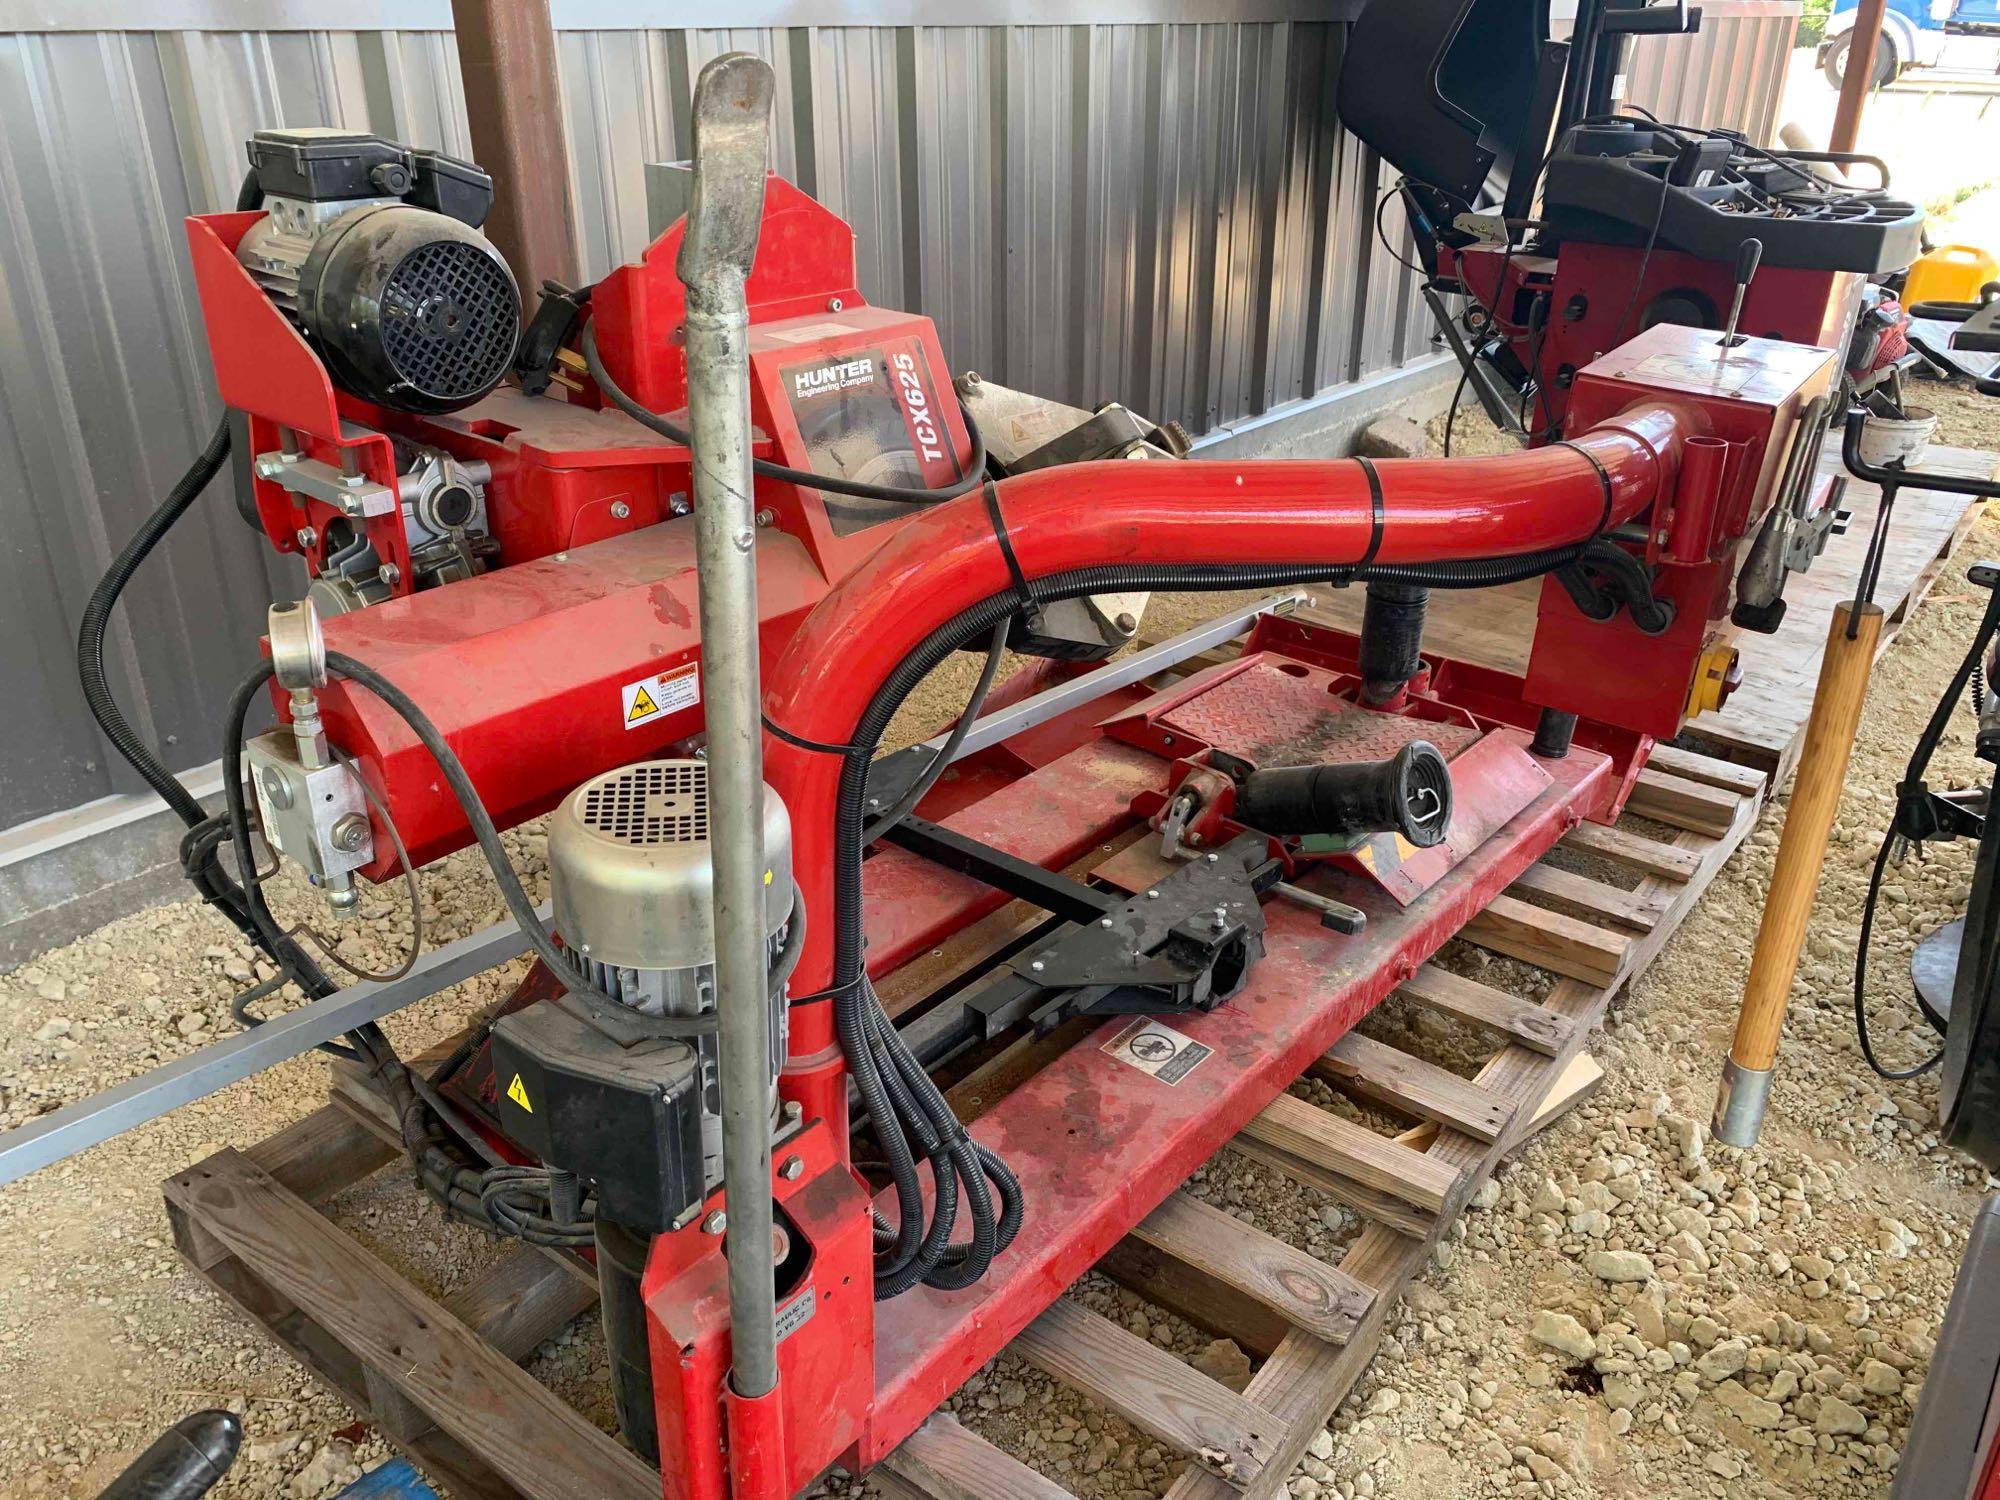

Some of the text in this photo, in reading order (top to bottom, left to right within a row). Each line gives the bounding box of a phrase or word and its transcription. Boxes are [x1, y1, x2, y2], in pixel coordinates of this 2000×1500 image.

[795, 359, 872, 389] HUNTER
[797, 374, 874, 398] Engineering Company
[892, 353, 942, 463] TCX625
[665, 666, 695, 681] WARNING
[775, 1305, 800, 1327] RAULIC
